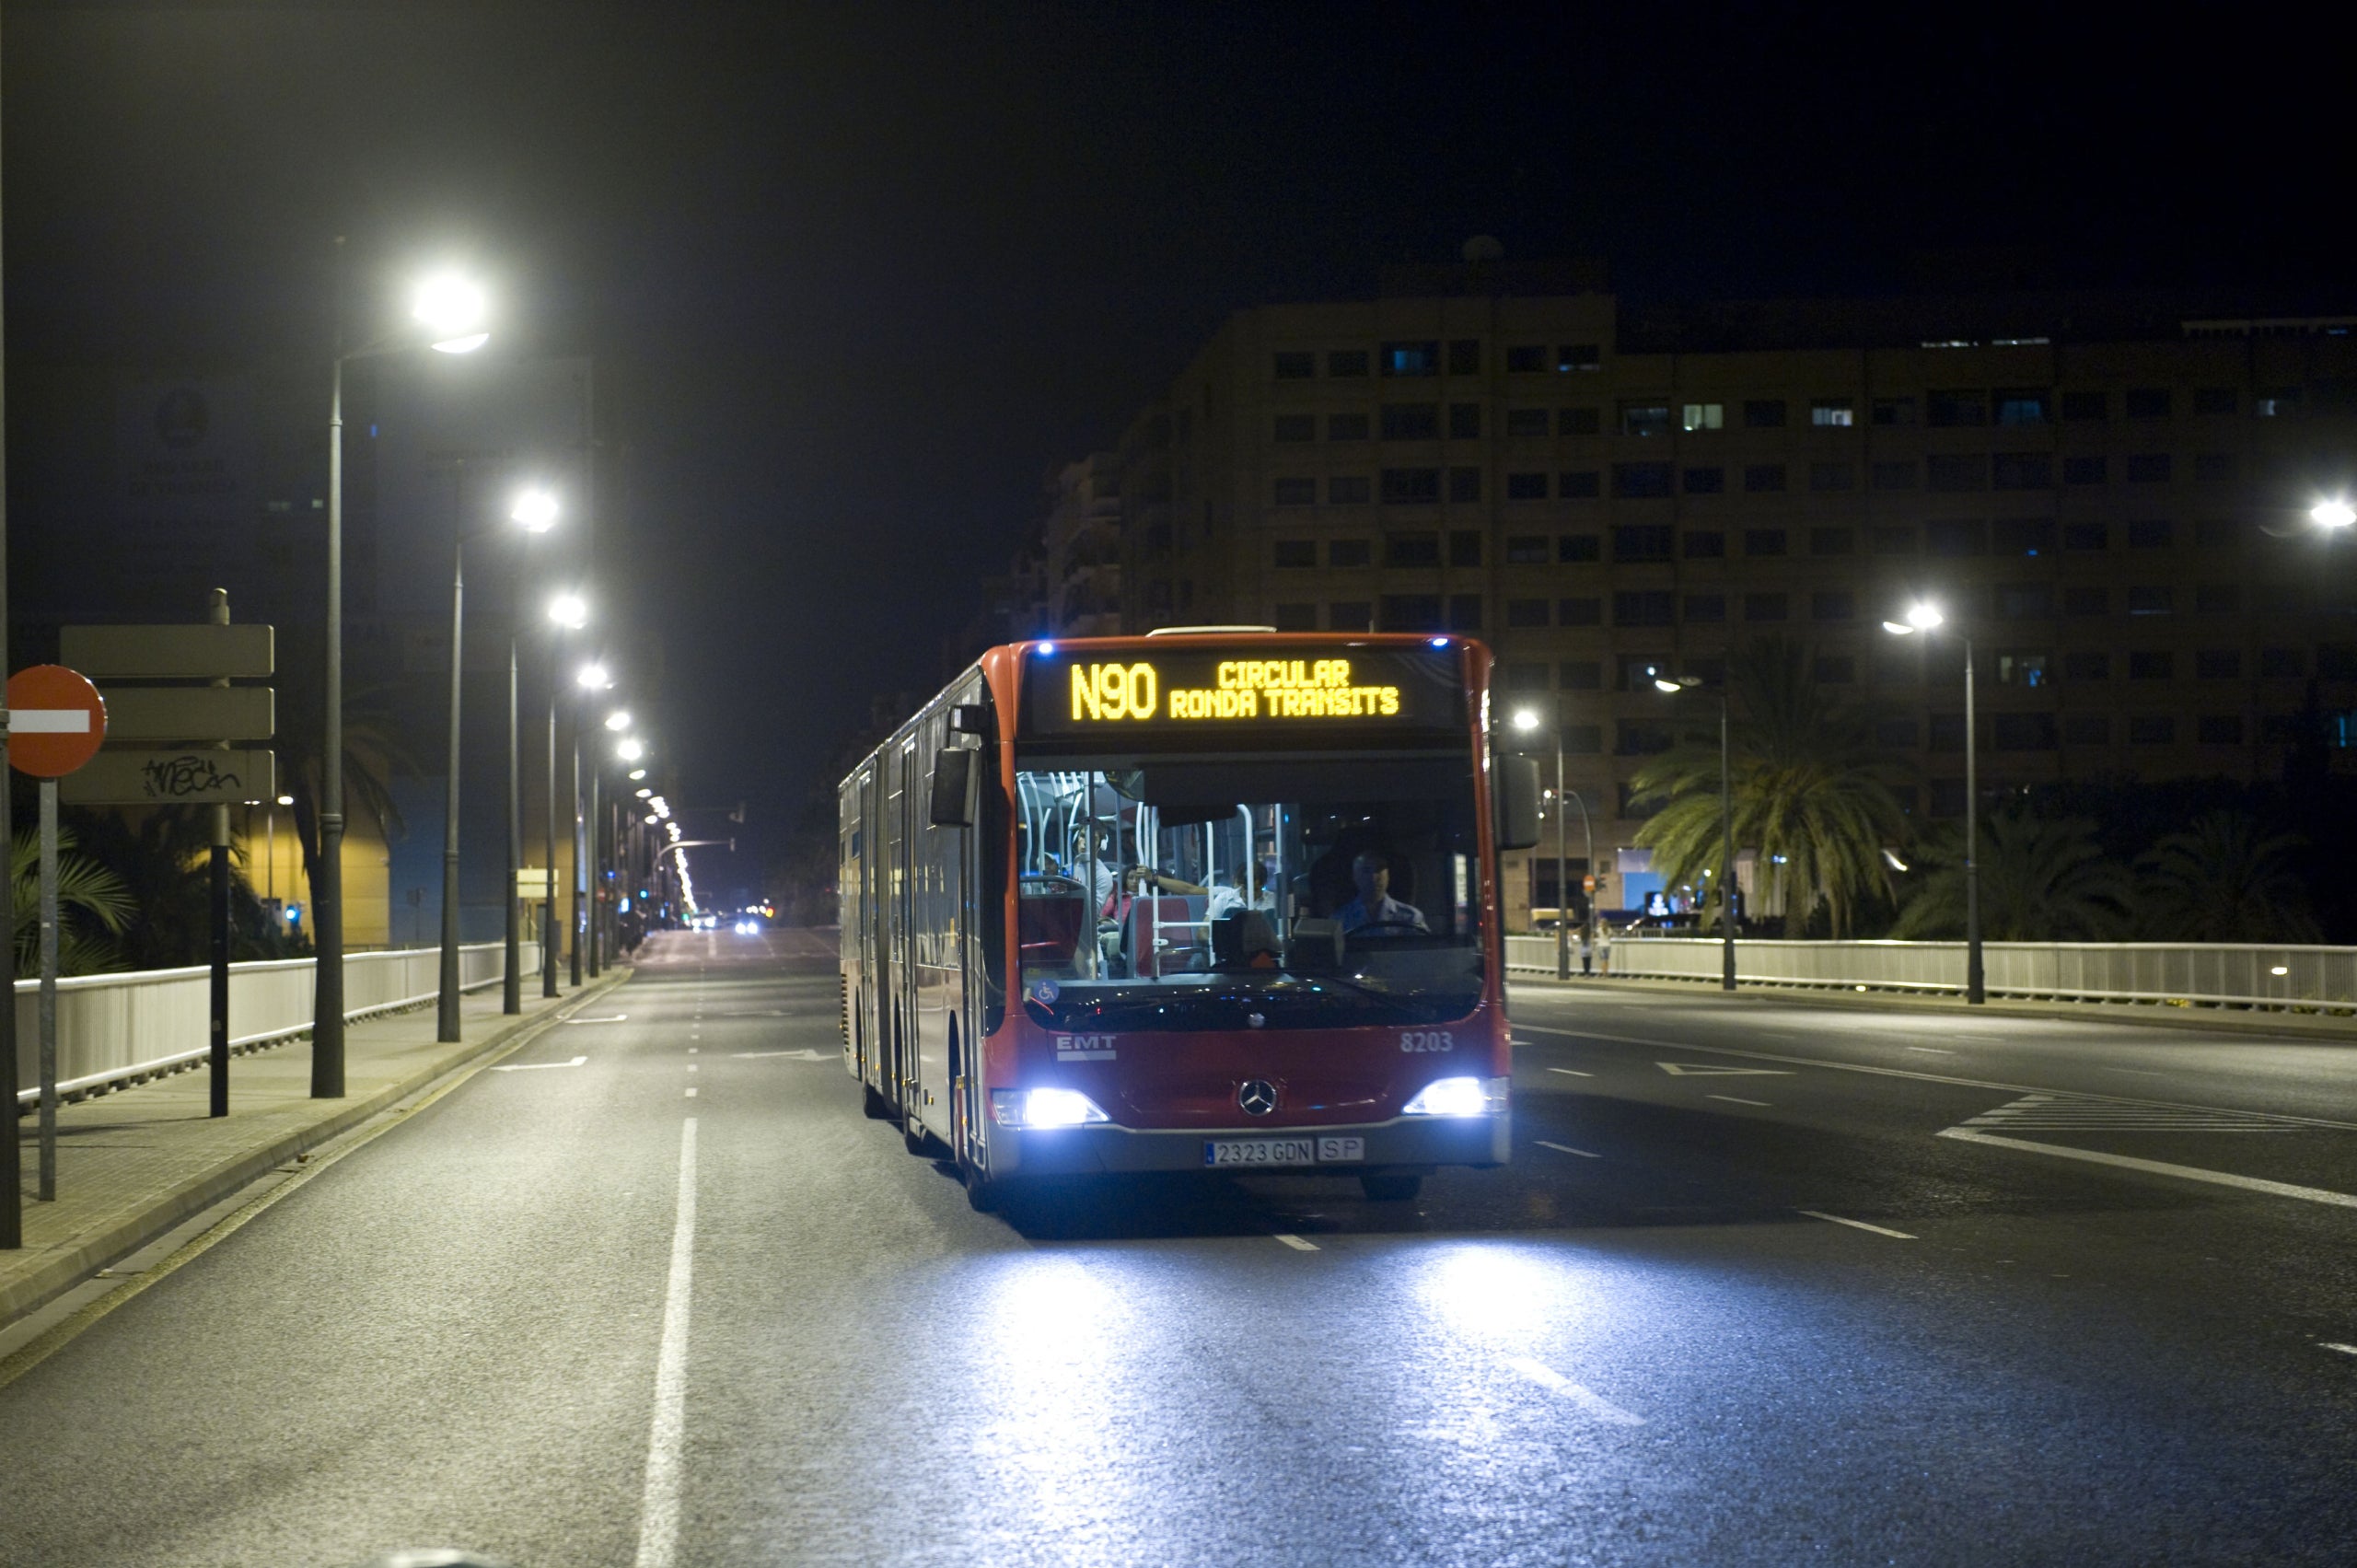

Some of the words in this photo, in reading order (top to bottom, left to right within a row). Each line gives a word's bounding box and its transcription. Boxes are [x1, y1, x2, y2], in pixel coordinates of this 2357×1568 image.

[1218, 660, 1351, 689] CIRCULAR
[1072, 663, 1156, 720] N90
[1170, 690, 1258, 719] RONDA
[1264, 687, 1399, 716] TRANSITS
[1056, 1036, 1117, 1050] EMT
[1400, 1031, 1453, 1052] 8203
[1218, 1144, 1268, 1163] 2323
[1272, 1142, 1310, 1162] GDN
